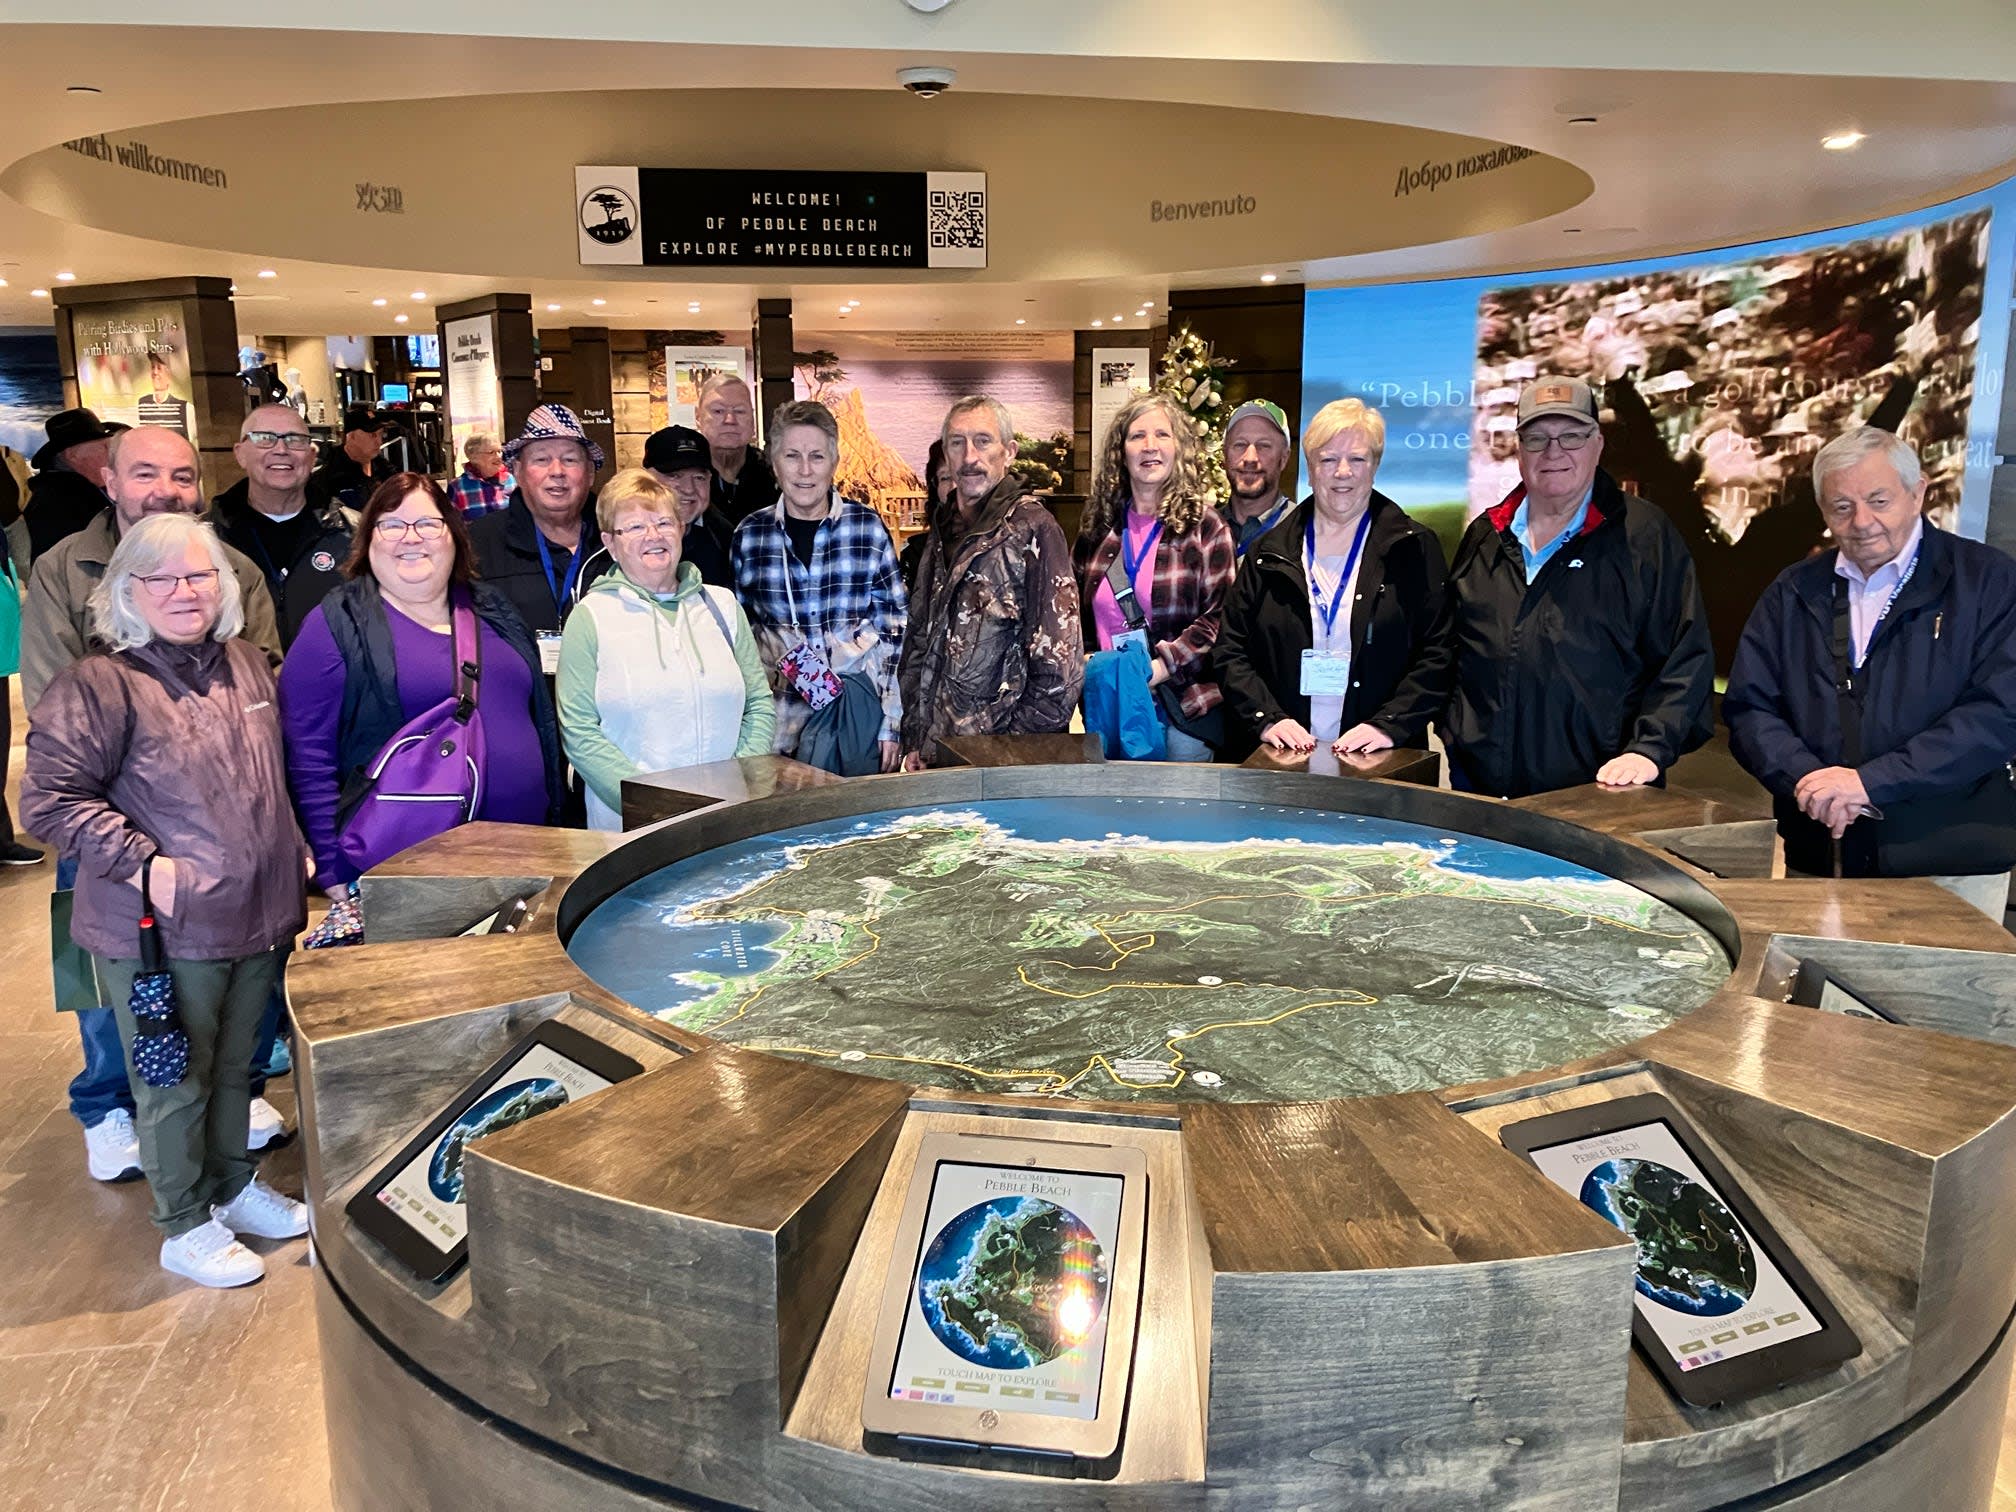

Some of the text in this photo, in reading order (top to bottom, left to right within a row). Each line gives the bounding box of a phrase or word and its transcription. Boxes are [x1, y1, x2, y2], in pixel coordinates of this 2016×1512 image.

[116, 141, 228, 189] willkommen
[1394, 160, 1452, 197] Добро
[752, 193, 840, 206] WELCOME!
[1150, 194, 1256, 223] Benvenuto
[706, 217, 877, 231] OF PEBBLE BEACH
[659, 242, 912, 257] EXPLORE #MYPEBBLEBEACH
[108, 320, 137, 335] Birdies
[140, 318, 155, 332] and
[83, 342, 101, 356] with
[150, 340, 174, 354] Stars
[1361, 381, 1492, 408] “Pebbl
[1703, 367, 1778, 411] golf
[1404, 432, 1471, 449] one
[985, 1179, 1072, 1196] PEBBLE BEACH
